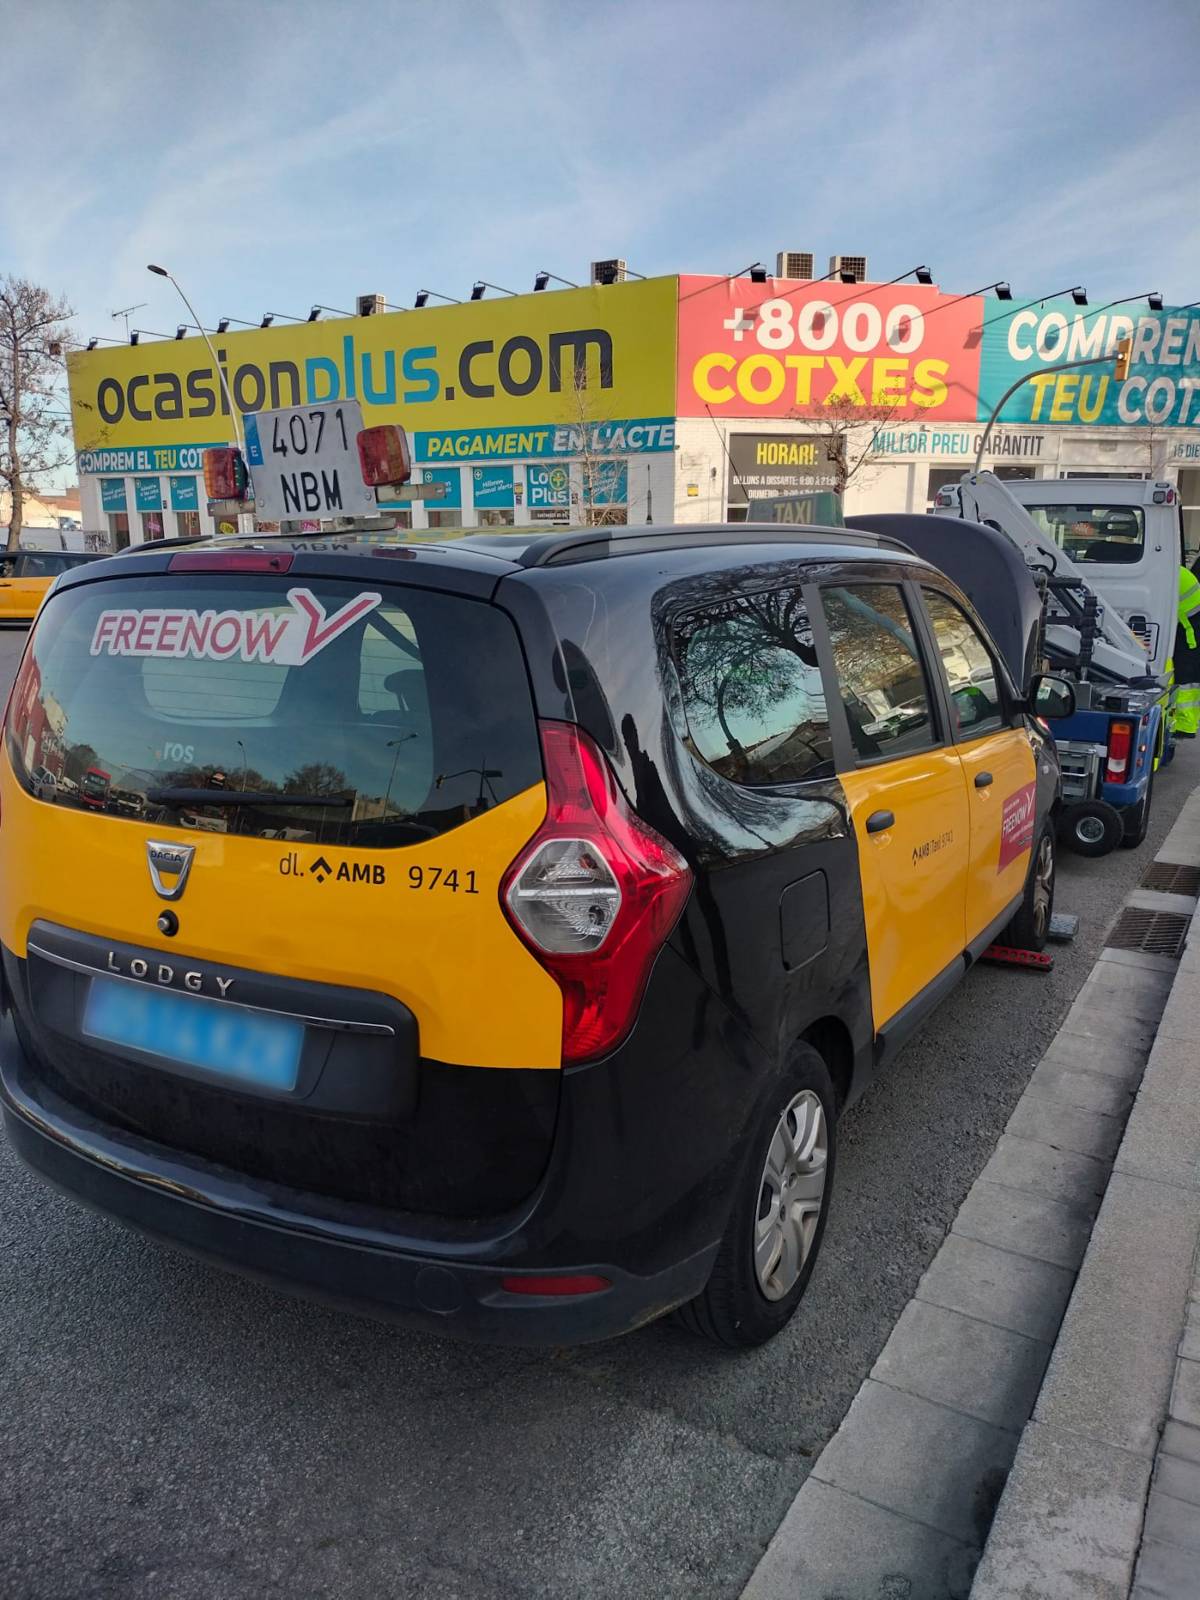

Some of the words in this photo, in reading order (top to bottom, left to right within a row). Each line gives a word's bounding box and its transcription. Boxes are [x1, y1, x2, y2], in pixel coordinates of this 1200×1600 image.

[723, 298, 926, 354] +8000
[97, 328, 614, 424] ocasionplus.com
[692, 352, 950, 408] COTXES
[1029, 374, 1109, 423] TEU
[1117, 376, 1200, 424] COT
[250, 446, 258, 458] E
[272, 408, 348, 458] 4071
[427, 432, 549, 457] PAGAMENT
[553, 430, 585, 452] EN
[591, 424, 675, 450] L'ACTE
[872, 431, 927, 454] MILLOR
[932, 433, 969, 455] PREU
[974, 434, 1044, 457] GARANTIT
[79, 451, 134, 472] COMPREM
[137, 450, 151, 470] EL
[153, 449, 177, 469] TEU
[180, 448, 205, 468] COT
[280, 469, 343, 513] NBM
[532, 488, 567, 503] Plus
[774, 500, 812, 524] TAXI
[95, 615, 290, 656] FREENOW
[150, 849, 182, 861] DACIA
[280, 852, 304, 877] dl.
[336, 861, 386, 885] AMB
[408, 865, 480, 894] 9741
[107, 951, 235, 997] LODGY
